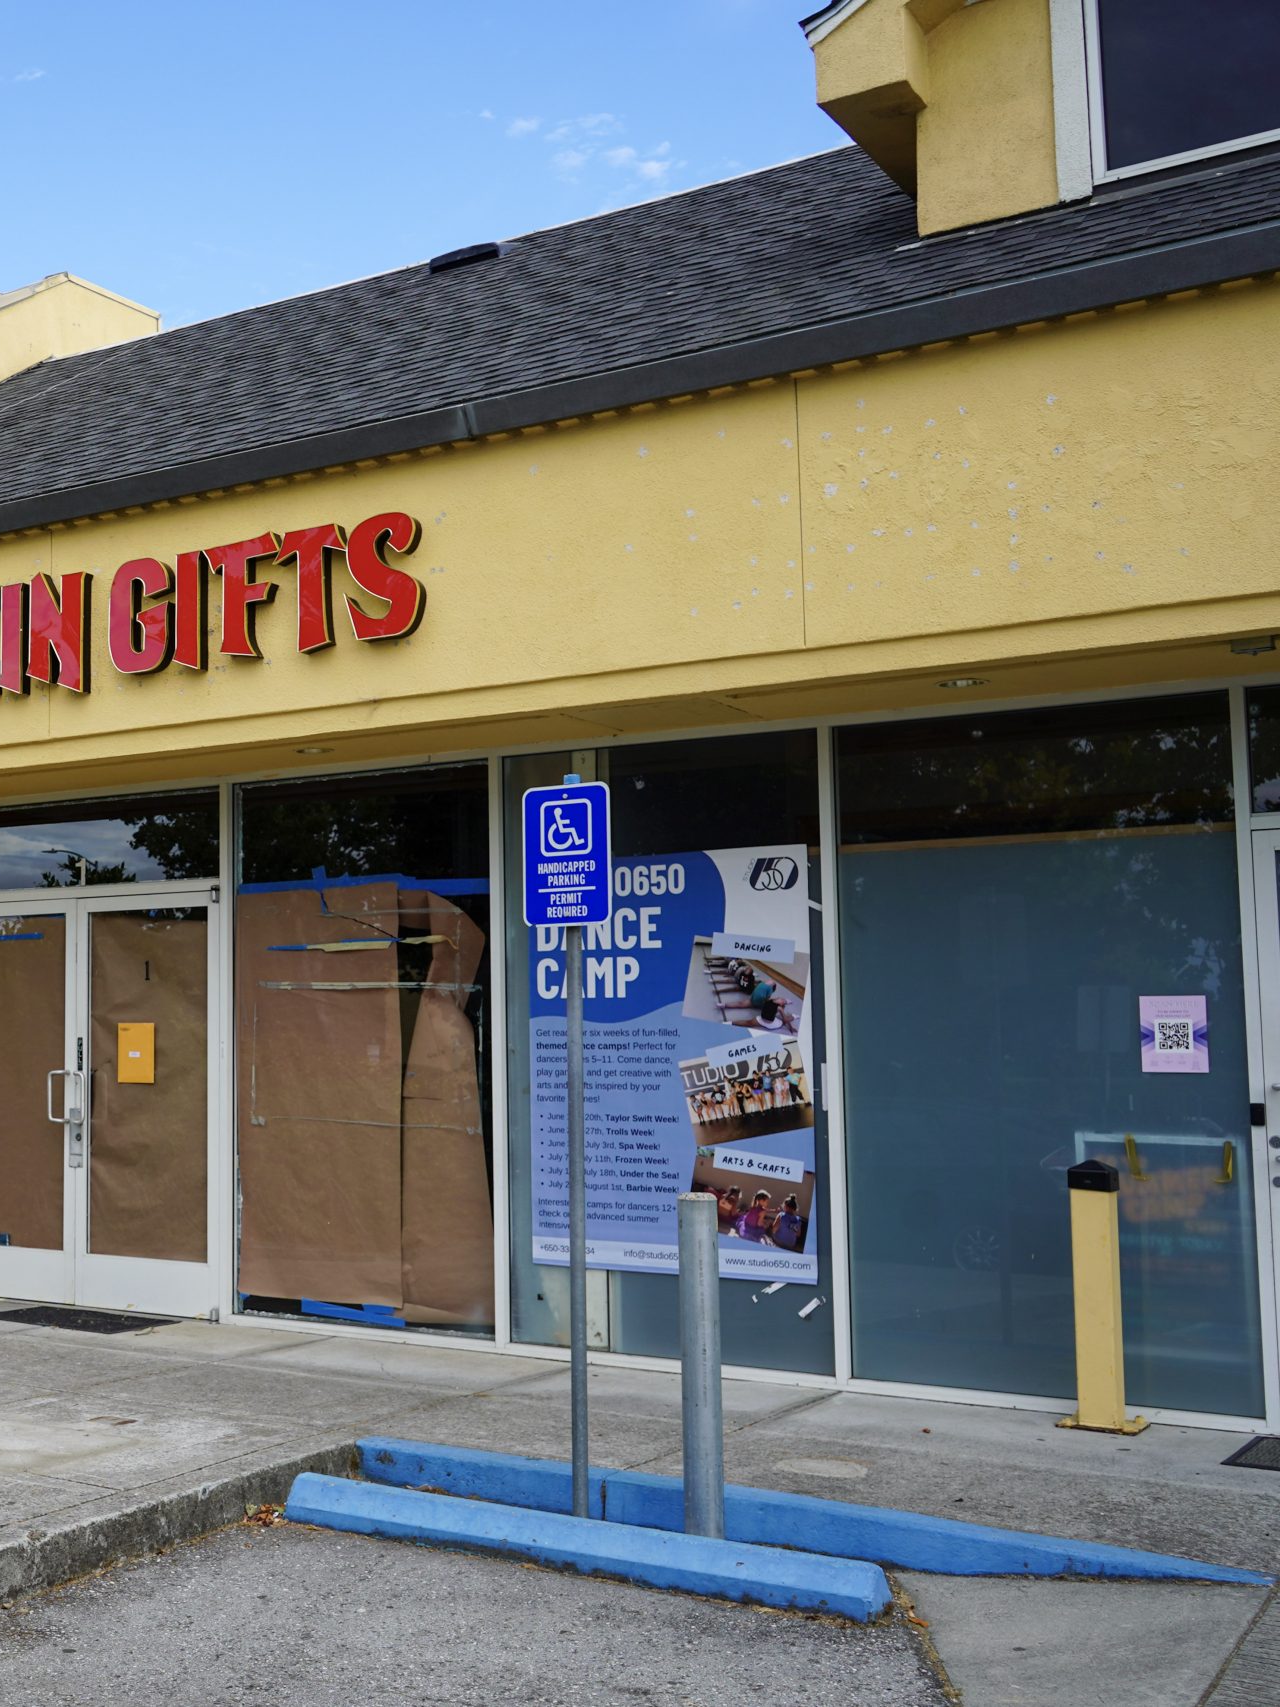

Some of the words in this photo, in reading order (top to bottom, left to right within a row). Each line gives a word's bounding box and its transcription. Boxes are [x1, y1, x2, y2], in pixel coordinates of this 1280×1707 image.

[108, 511, 427, 675] GIFTS
[538, 860, 596, 874] HANDICAPPED
[548, 874, 586, 886] PARKING
[550, 892, 582, 905] PERMIT
[547, 905, 588, 918] REQUIRED
[734, 942, 771, 952] DANCING
[536, 1029, 551, 1037] Get
[590, 1029, 601, 1037] six
[603, 1029, 630, 1037] weeks
[632, 1029, 640, 1037] of
[642, 1028, 681, 1038] fun-filled,
[536, 1042, 567, 1050] themed
[598, 1042, 630, 1052] camps!
[633, 1042, 663, 1050] Perfect
[665, 1042, 676, 1051] for
[728, 1044, 757, 1058] GAMES
[536, 1055, 567, 1063] dancers
[617, 1055, 641, 1064] Come
[644, 1055, 673, 1065] dance,
[536, 1068, 552, 1078] play
[604, 1069, 617, 1079] get
[620, 1069, 652, 1077] creative
[654, 1069, 671, 1078] with
[554, 1081, 568, 1089] and
[595, 1082, 628, 1092] inspired
[630, 1082, 640, 1092] by
[643, 1084, 661, 1092] your
[536, 1094, 565, 1102] favorite
[585, 1113, 604, 1122] 20th,
[606, 1114, 630, 1124] Taylor
[632, 1114, 652, 1123] Swift
[654, 1115, 679, 1123] Week!
[547, 1126, 565, 1134] June
[585, 1127, 604, 1136] 27th,
[606, 1128, 629, 1136] Trolls
[631, 1128, 655, 1136] Week!
[547, 1139, 565, 1148] June
[585, 1140, 600, 1150] July
[619, 1142, 634, 1151] Spa
[635, 1142, 661, 1150] Week!
[547, 1153, 563, 1162] July
[615, 1156, 643, 1164] Frozen
[644, 1157, 669, 1165] Week!
[722, 1156, 744, 1166] ARTS
[747, 1159, 754, 1168] &
[757, 1162, 791, 1175] CRAFTS
[547, 1167, 563, 1176] July
[620, 1170, 644, 1178] Under
[646, 1170, 659, 1178] the
[661, 1172, 680, 1180] Sea!
[548, 1180, 563, 1190] July
[626, 1184, 652, 1192] Barbie
[654, 1185, 680, 1193] Week!
[587, 1202, 613, 1211] camps
[615, 1202, 625, 1210] for
[627, 1202, 660, 1211] dancers
[538, 1209, 561, 1217] check
[587, 1213, 624, 1222] advanced
[627, 1216, 659, 1224] summer
[725, 1258, 811, 1270] www.studio650.com
